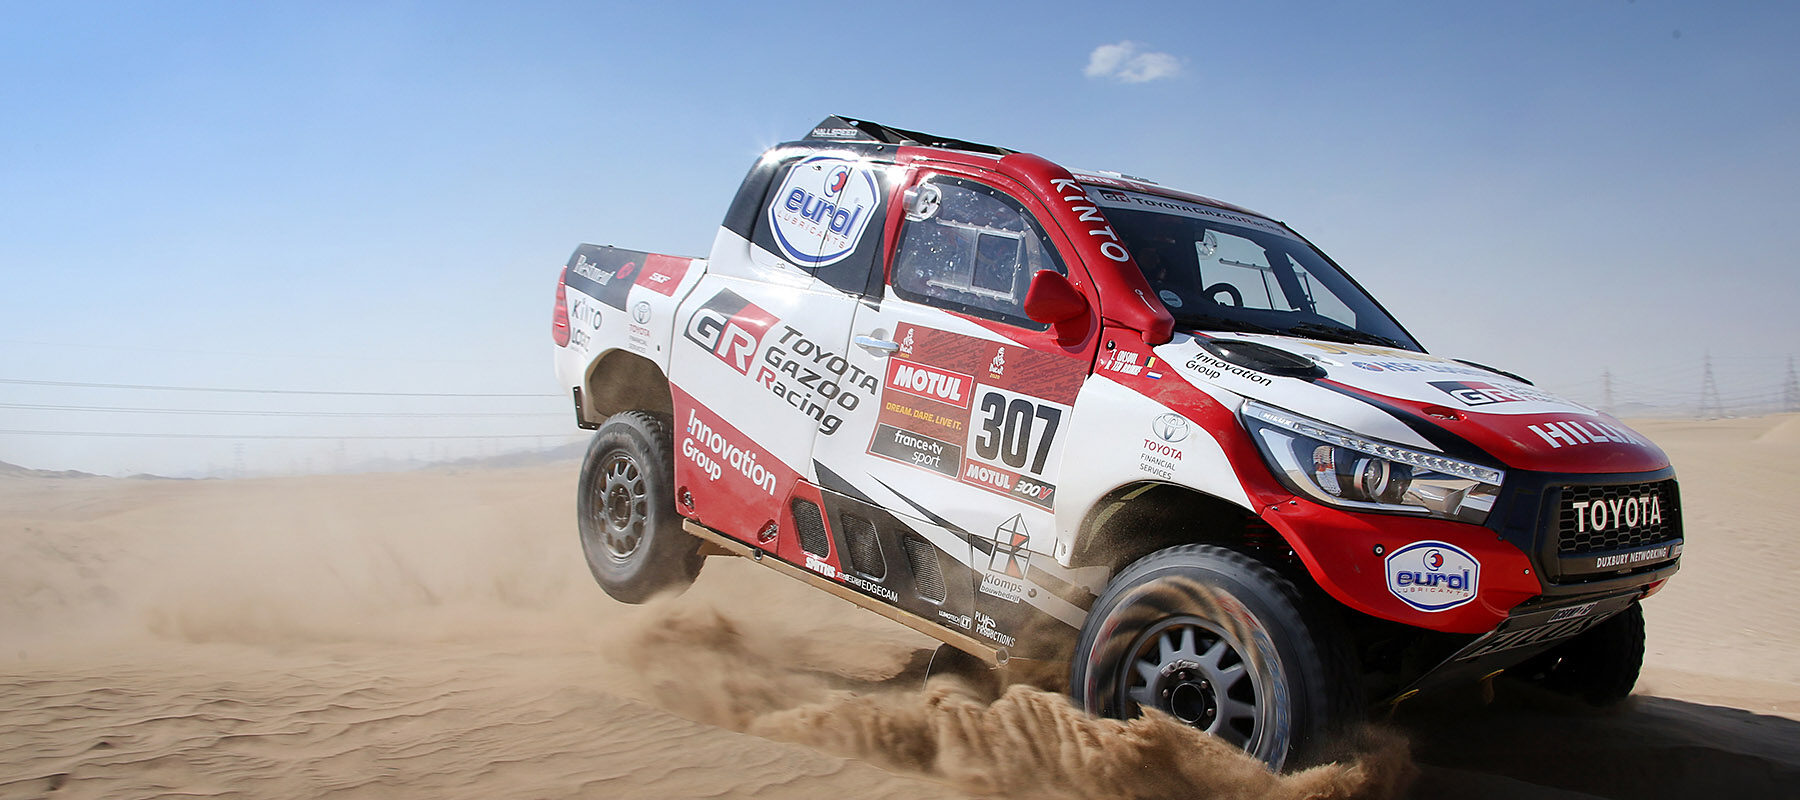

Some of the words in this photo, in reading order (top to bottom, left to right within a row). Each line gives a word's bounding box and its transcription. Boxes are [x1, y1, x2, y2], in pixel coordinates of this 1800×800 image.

[784, 186, 864, 240] eurol
[1132, 196, 1194, 213] TOYOTA
[777, 210, 846, 250] LUBRICANTS
[1050, 178, 1129, 262] KINTO
[688, 308, 757, 372] GR
[778, 325, 879, 396] TOYOTA
[1186, 360, 1221, 380] Group
[1195, 352, 1272, 387] Innovation
[764, 345, 861, 412] GAZOO
[893, 365, 962, 402] MOTUL
[756, 365, 843, 436] Racing
[1450, 388, 1525, 405] GR
[885, 402, 912, 418] DREAM.
[913, 408, 935, 424] DARE.
[935, 413, 952, 428] LIVE
[951, 420, 962, 431] IT.
[975, 391, 1062, 475] 307
[1528, 421, 1647, 448] HILUX
[683, 438, 722, 481] Group
[911, 451, 941, 468] sport
[1141, 453, 1175, 471] FINANCIAL
[1144, 439, 1182, 461] TOYOTA
[966, 463, 1011, 490] MOTUL
[1014, 480, 1054, 501] 300V
[1139, 463, 1172, 480] SERVICES
[1572, 496, 1662, 533] TOYOTA
[1596, 552, 1630, 568] DUXBURY
[1629, 547, 1667, 563] NETWORKING
[861, 580, 898, 602] EDGECAM
[983, 573, 1022, 592] Klomps
[1396, 568, 1470, 591] eurol
[1397, 587, 1469, 597] LUBRICANTS
[980, 585, 1020, 602] bouwbedrijf
[976, 624, 1015, 648] PRODUCTIONS
